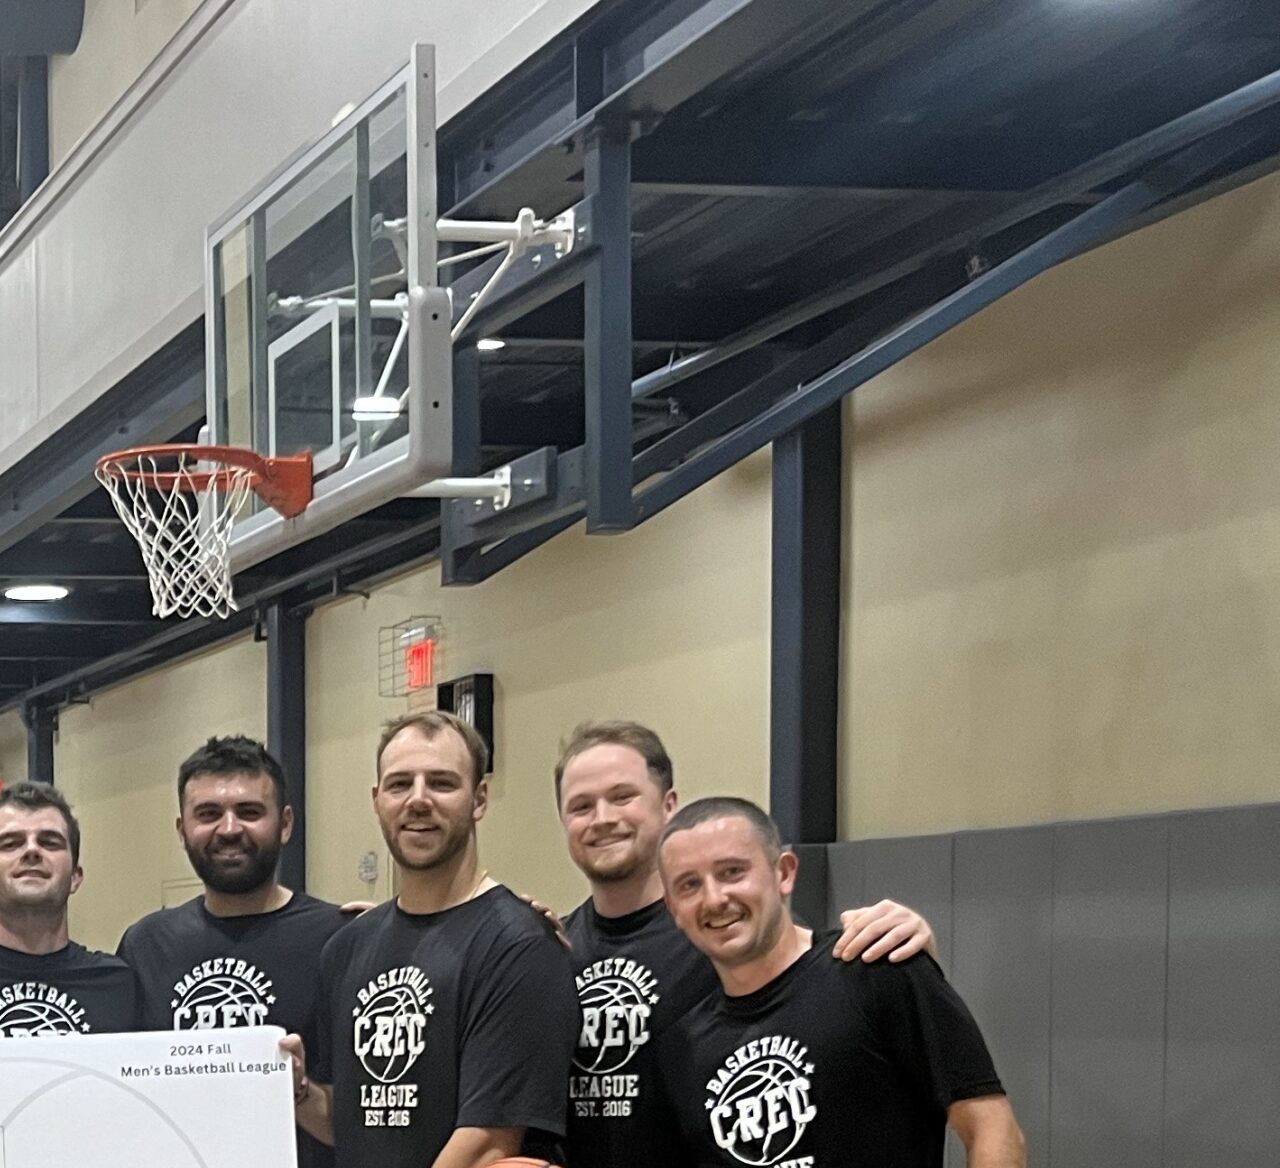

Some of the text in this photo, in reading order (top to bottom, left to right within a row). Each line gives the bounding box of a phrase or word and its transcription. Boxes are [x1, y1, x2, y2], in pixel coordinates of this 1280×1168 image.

[173, 957, 273, 997] BASKETBALL
[356, 965, 433, 1006] BASKETBALL
[574, 957, 659, 997] ASKETBALL
[354, 1013, 427, 1057] CREC
[578, 1003, 652, 1048] REC
[120, 1060, 287, 1077] Men's Basketball League
[170, 1043, 232, 1057] 2024 Fall
[705, 1034, 809, 1095] BASKETBALL
[360, 1083, 419, 1109] LEAGUE
[569, 1074, 640, 1099] LEAGUE
[575, 1099, 633, 1118] EST. 2016
[709, 1076, 818, 1150] CREC
